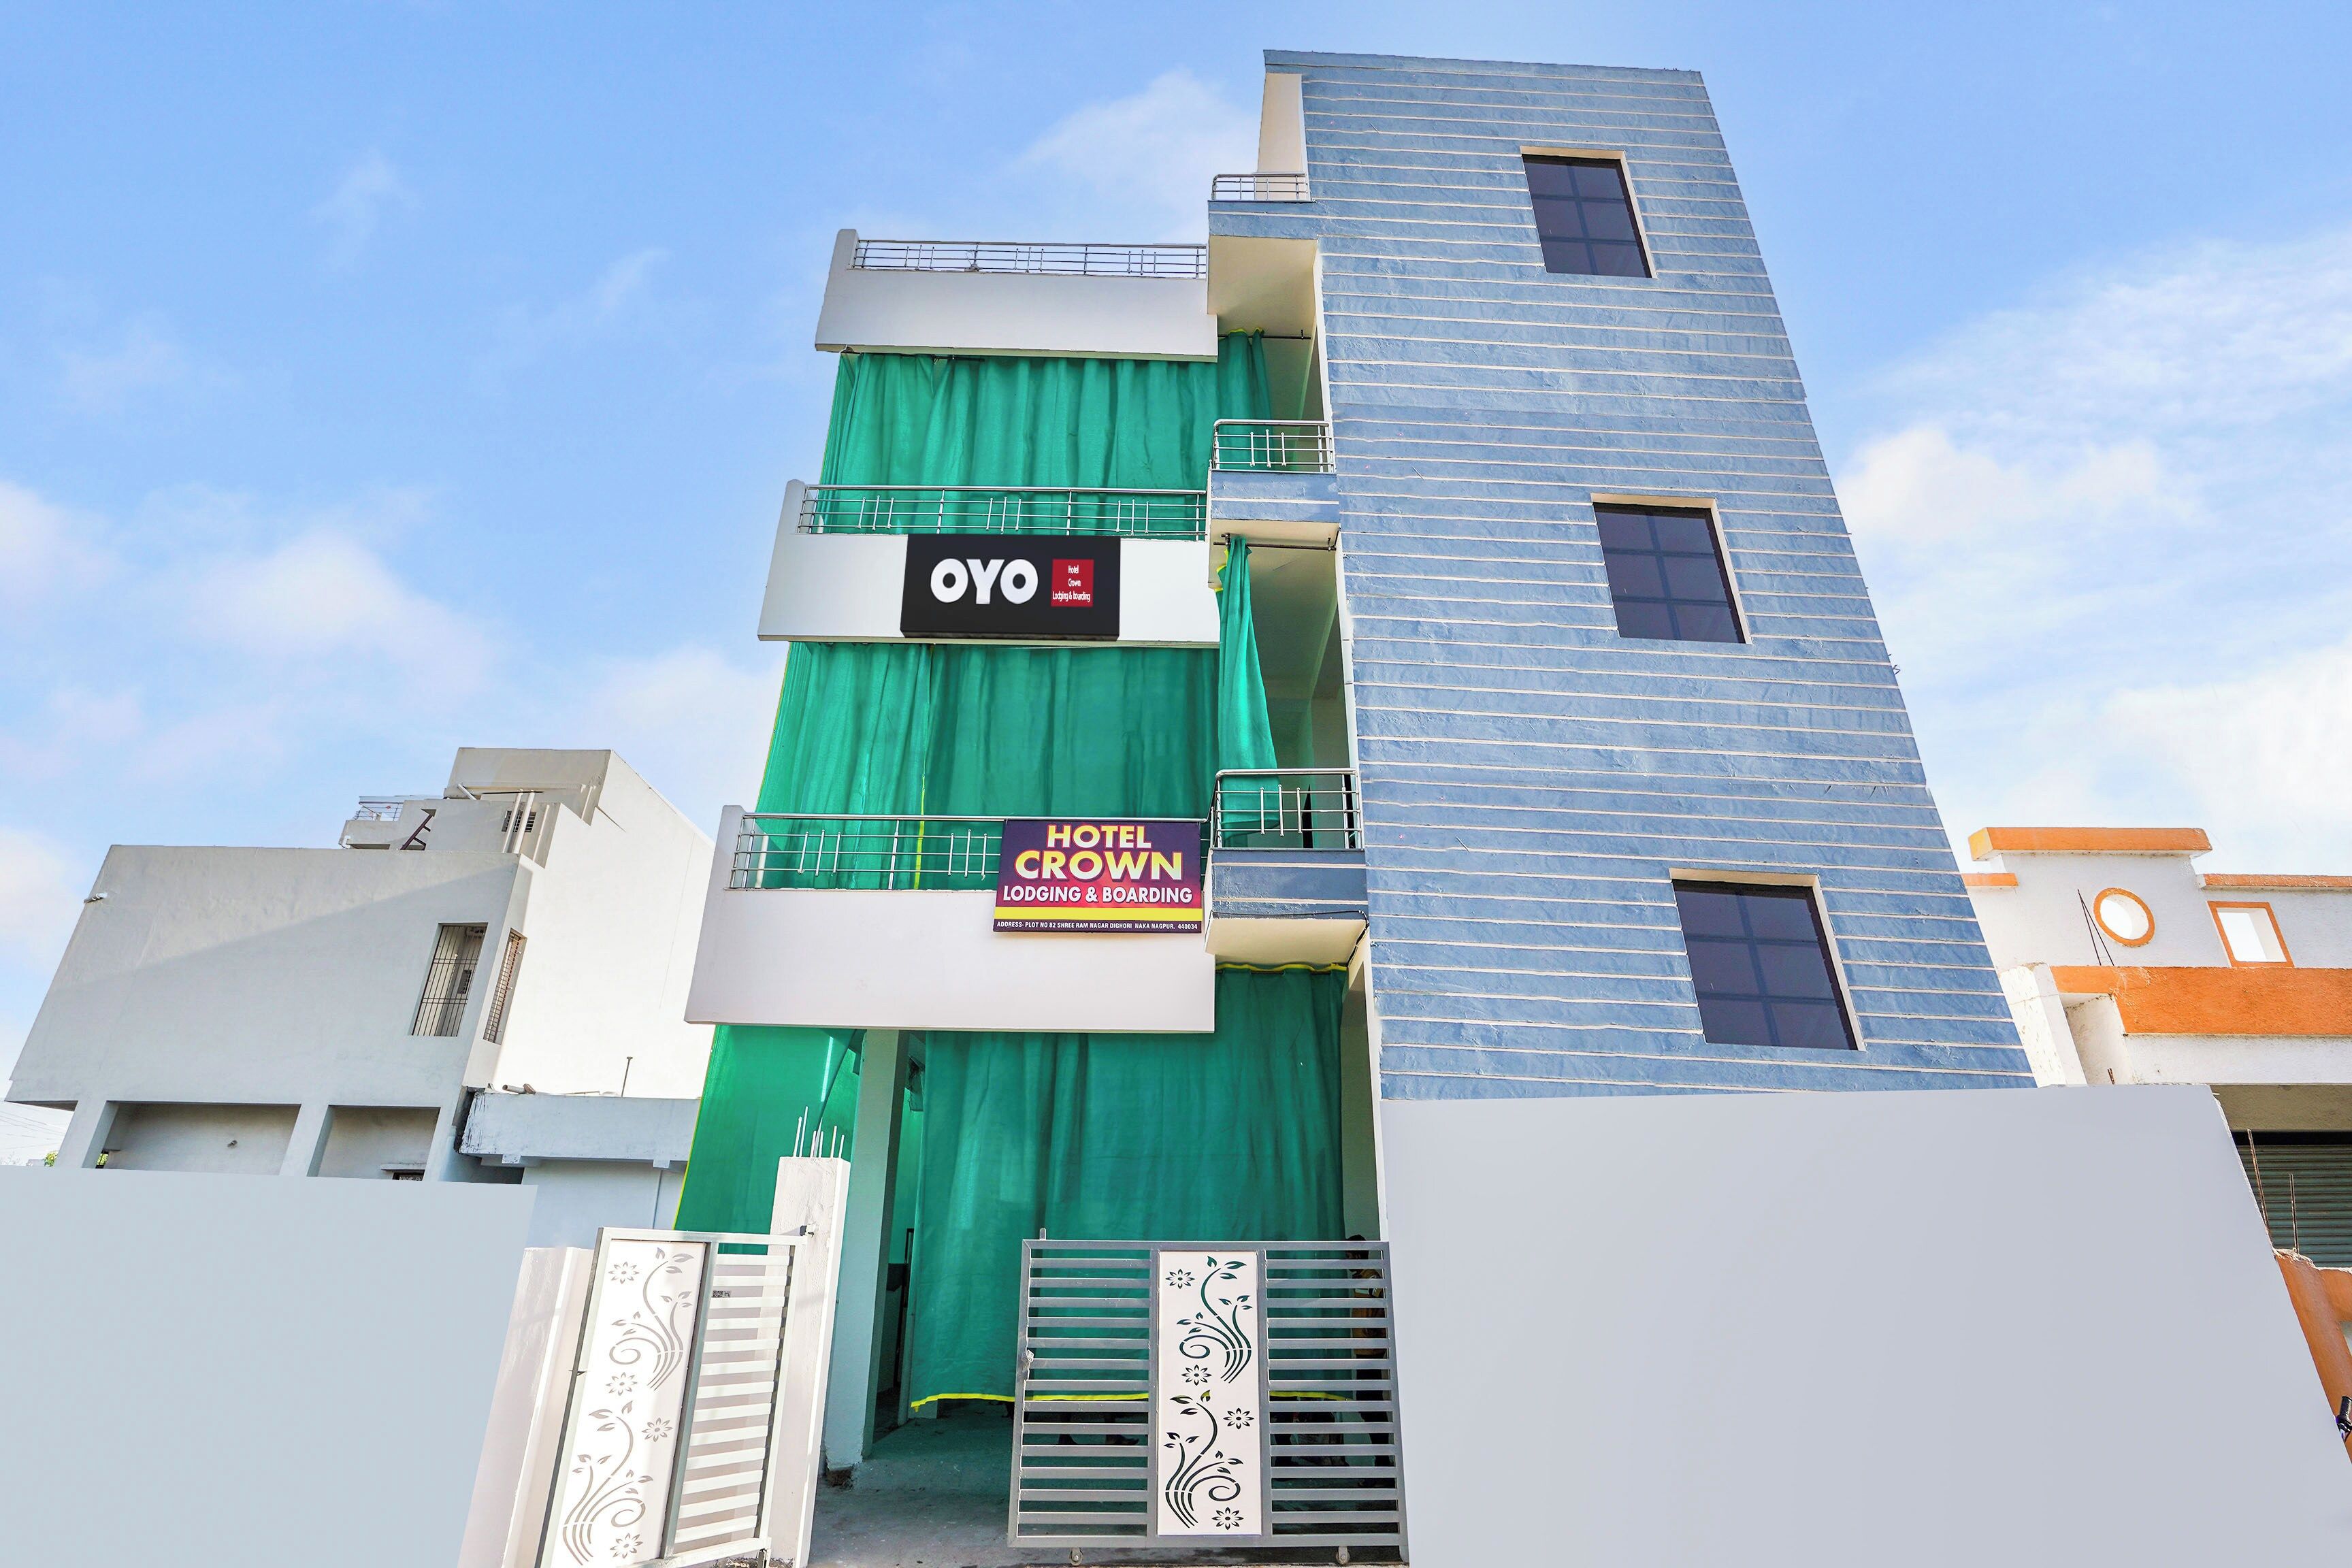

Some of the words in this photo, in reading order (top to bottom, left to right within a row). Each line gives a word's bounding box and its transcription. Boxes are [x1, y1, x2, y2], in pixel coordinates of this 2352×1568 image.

[1068, 565, 1079, 574] Hotel
[930, 558, 1039, 604] OYO
[1068, 578, 1081, 587] Crown
[1053, 591, 1068, 602] Lodging
[1069, 591, 1072, 600] &
[1073, 591, 1090, 602] boarding
[1047, 824, 1152, 849] HOTEL
[1015, 850, 1183, 881] CROWN
[1003, 885, 1081, 902] LODGING
[1085, 887, 1098, 902] &
[1102, 887, 1192, 904] BOARDING
